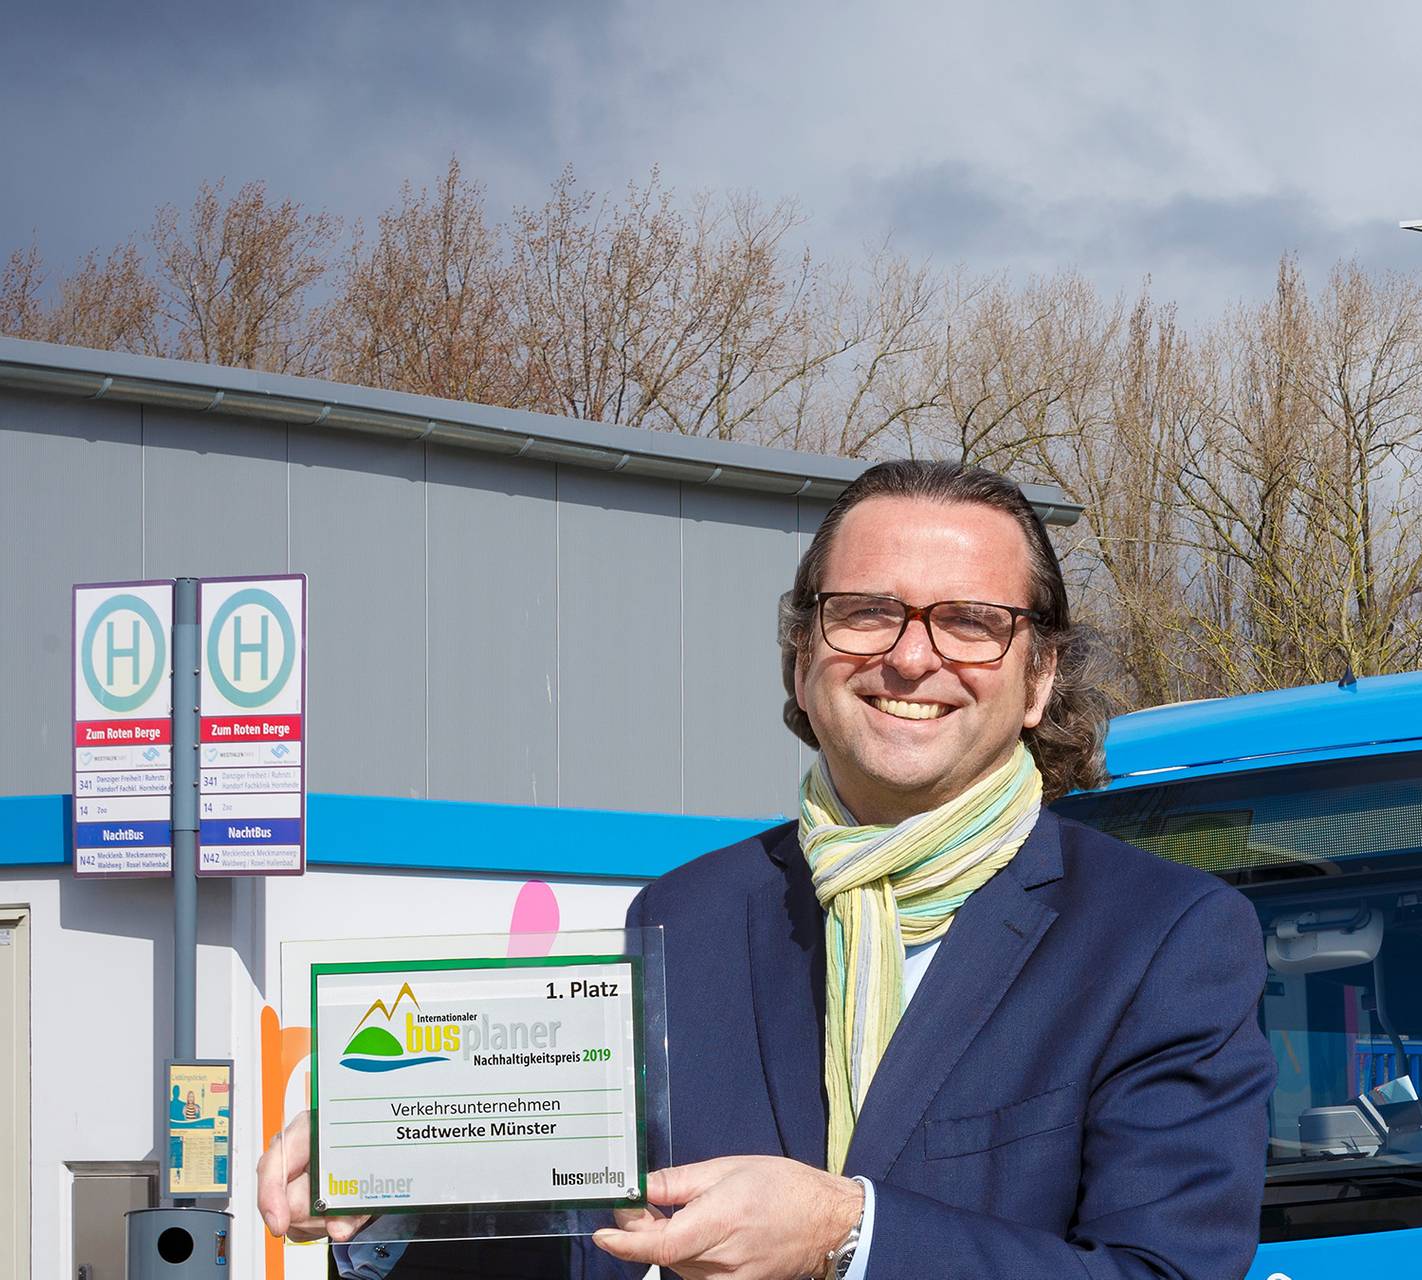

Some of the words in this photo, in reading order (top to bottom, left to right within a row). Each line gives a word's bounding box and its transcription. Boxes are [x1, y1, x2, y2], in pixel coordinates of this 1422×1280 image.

[107, 620, 140, 686] H
[234, 615, 268, 681] H
[86, 728, 105, 740] Zum
[107, 727, 133, 740] Roten
[135, 726, 161, 741] Berge
[211, 724, 232, 736] Zum
[233, 723, 260, 735] Roten
[262, 722, 290, 737] Berge
[80, 780, 93, 790] 341
[96, 775, 120, 784] Danziger
[204, 776, 218, 787] 341
[80, 806, 88, 815] 14
[204, 803, 213, 812] 14
[102, 829, 144, 841] NachtBus
[228, 826, 272, 839] NachtBus
[80, 855, 96, 866] N42
[203, 853, 220, 864] N42
[546, 982, 563, 999] 1.
[570, 980, 619, 998] Platz
[417, 1012, 478, 1023] Internationaler
[405, 1012, 561, 1061] busplaner
[473, 1051, 581, 1066] Nachhaltigkeitspreis
[582, 1048, 611, 1062] 2019
[390, 1098, 561, 1117] Verkehrsunternehmen
[396, 1124, 486, 1140] Stadtwerke
[490, 1122, 557, 1137] Münster
[552, 1166, 625, 1187] hussverlag
[328, 1172, 414, 1199] busplaner
